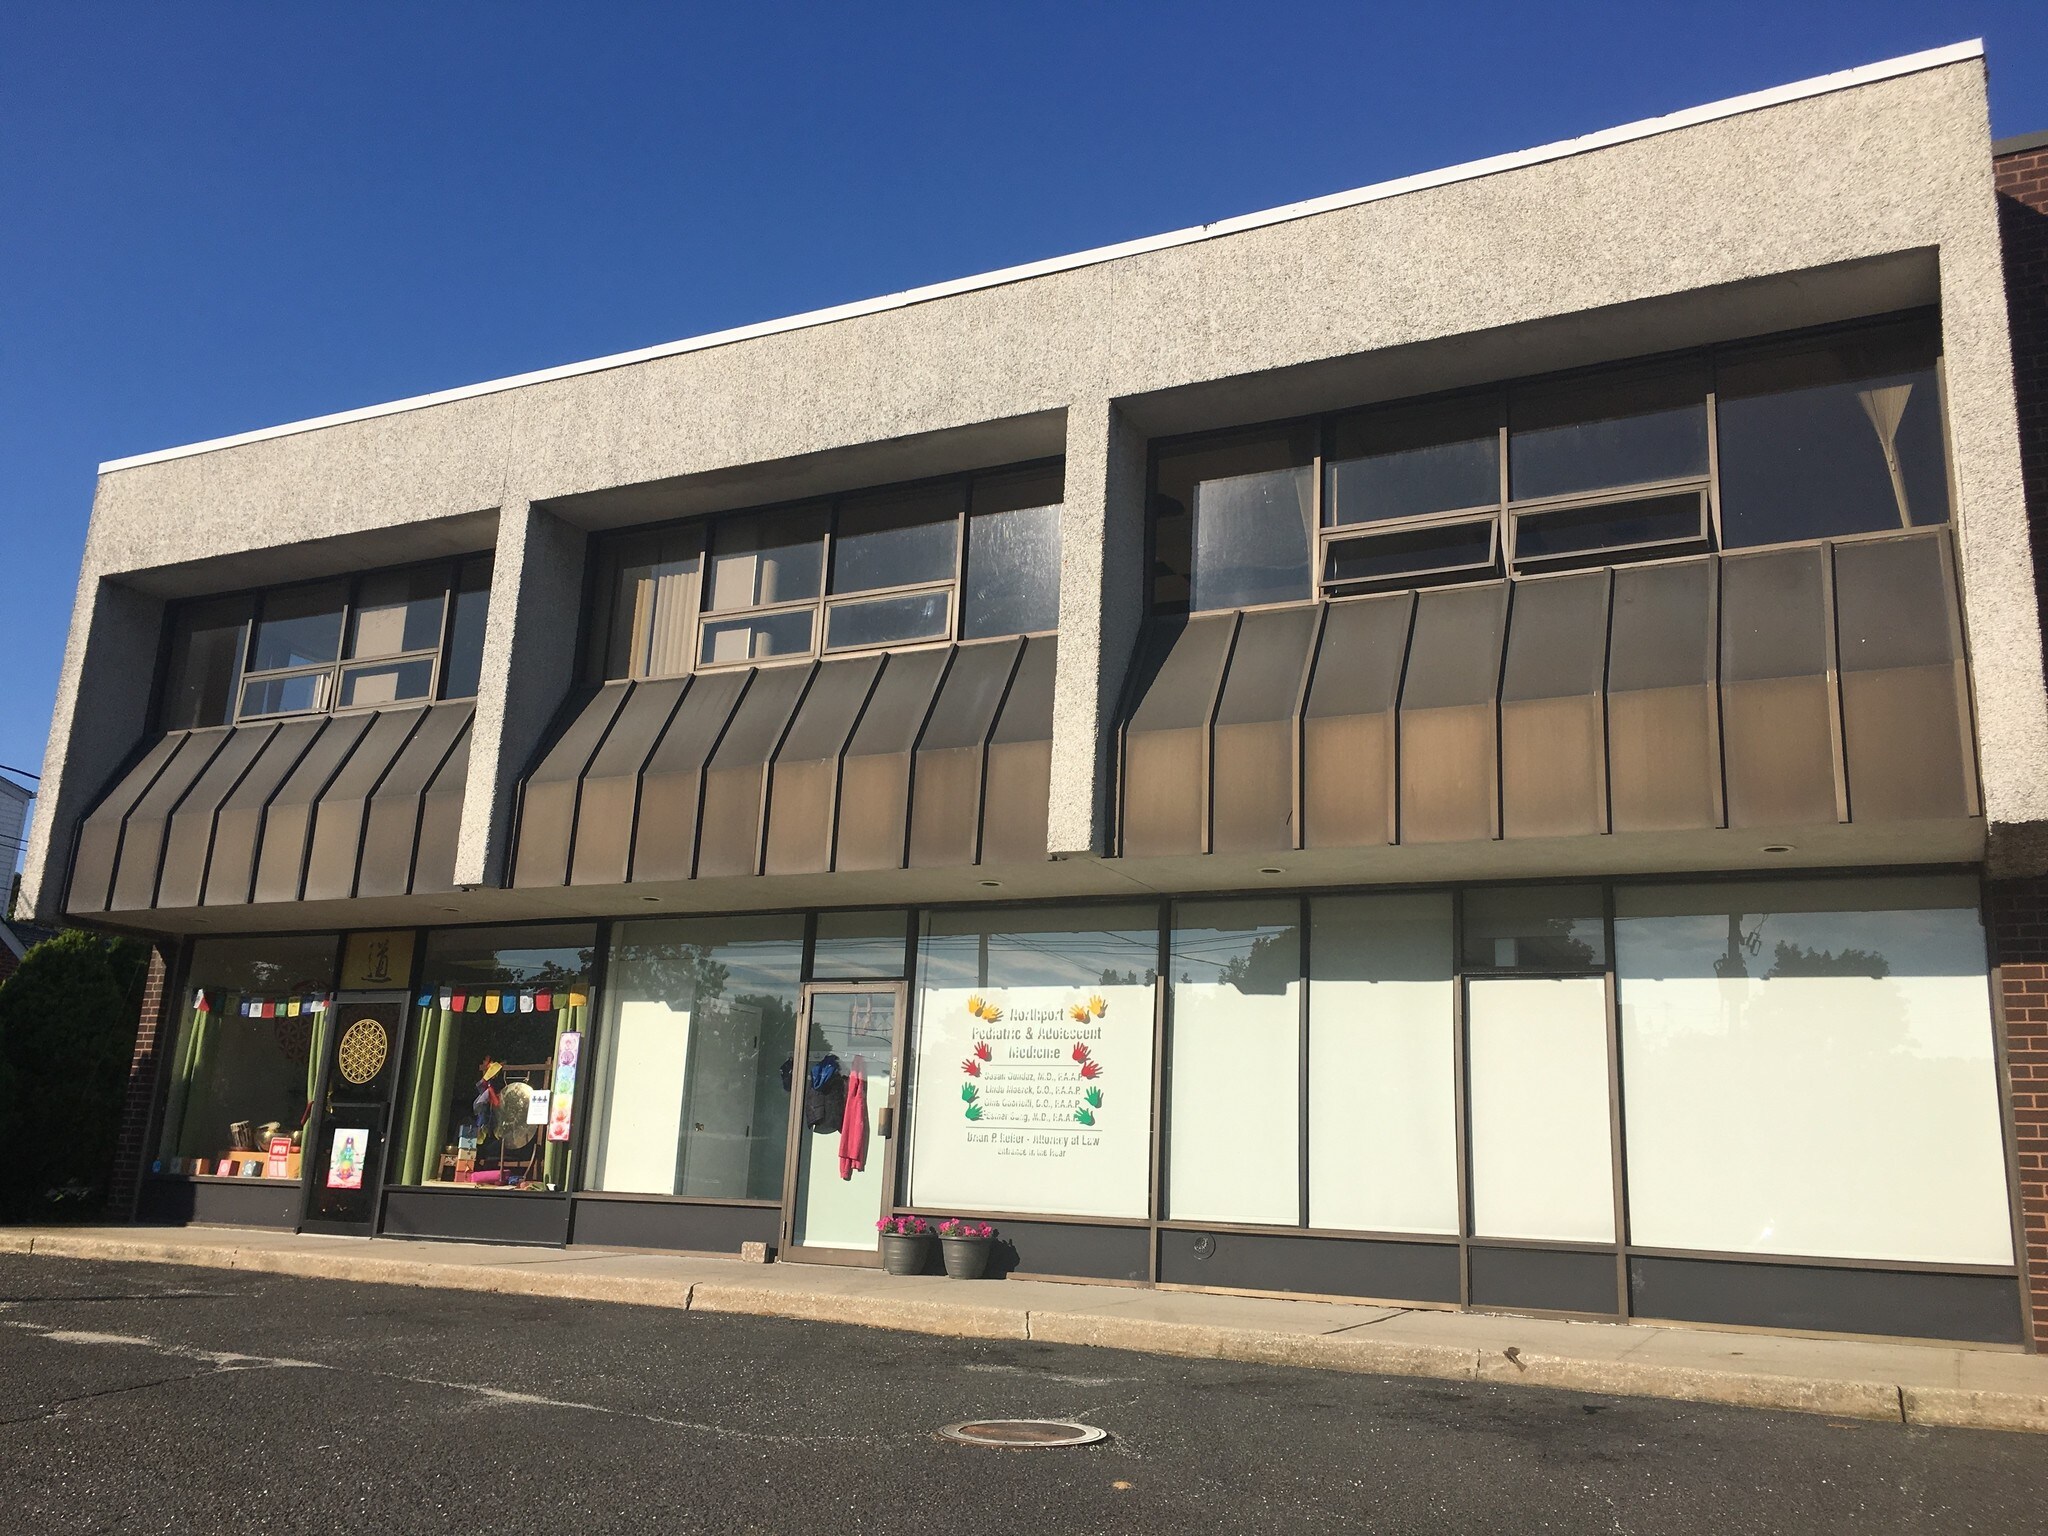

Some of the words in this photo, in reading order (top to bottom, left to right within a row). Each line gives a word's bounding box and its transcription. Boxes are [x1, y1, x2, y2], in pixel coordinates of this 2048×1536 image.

[1009, 1007, 1064, 1024] Northport
[971, 1026, 1022, 1040] Pediatric
[1024, 1026, 1034, 1040] &
[1037, 1026, 1102, 1040] Adolescent
[1008, 1044, 1061, 1059] Medicine
[991, 1132, 998, 1143] P.
[1070, 1134, 1080, 1146] at
[1081, 1134, 1100, 1146] Law
[271, 1144, 287, 1155] OPEN
